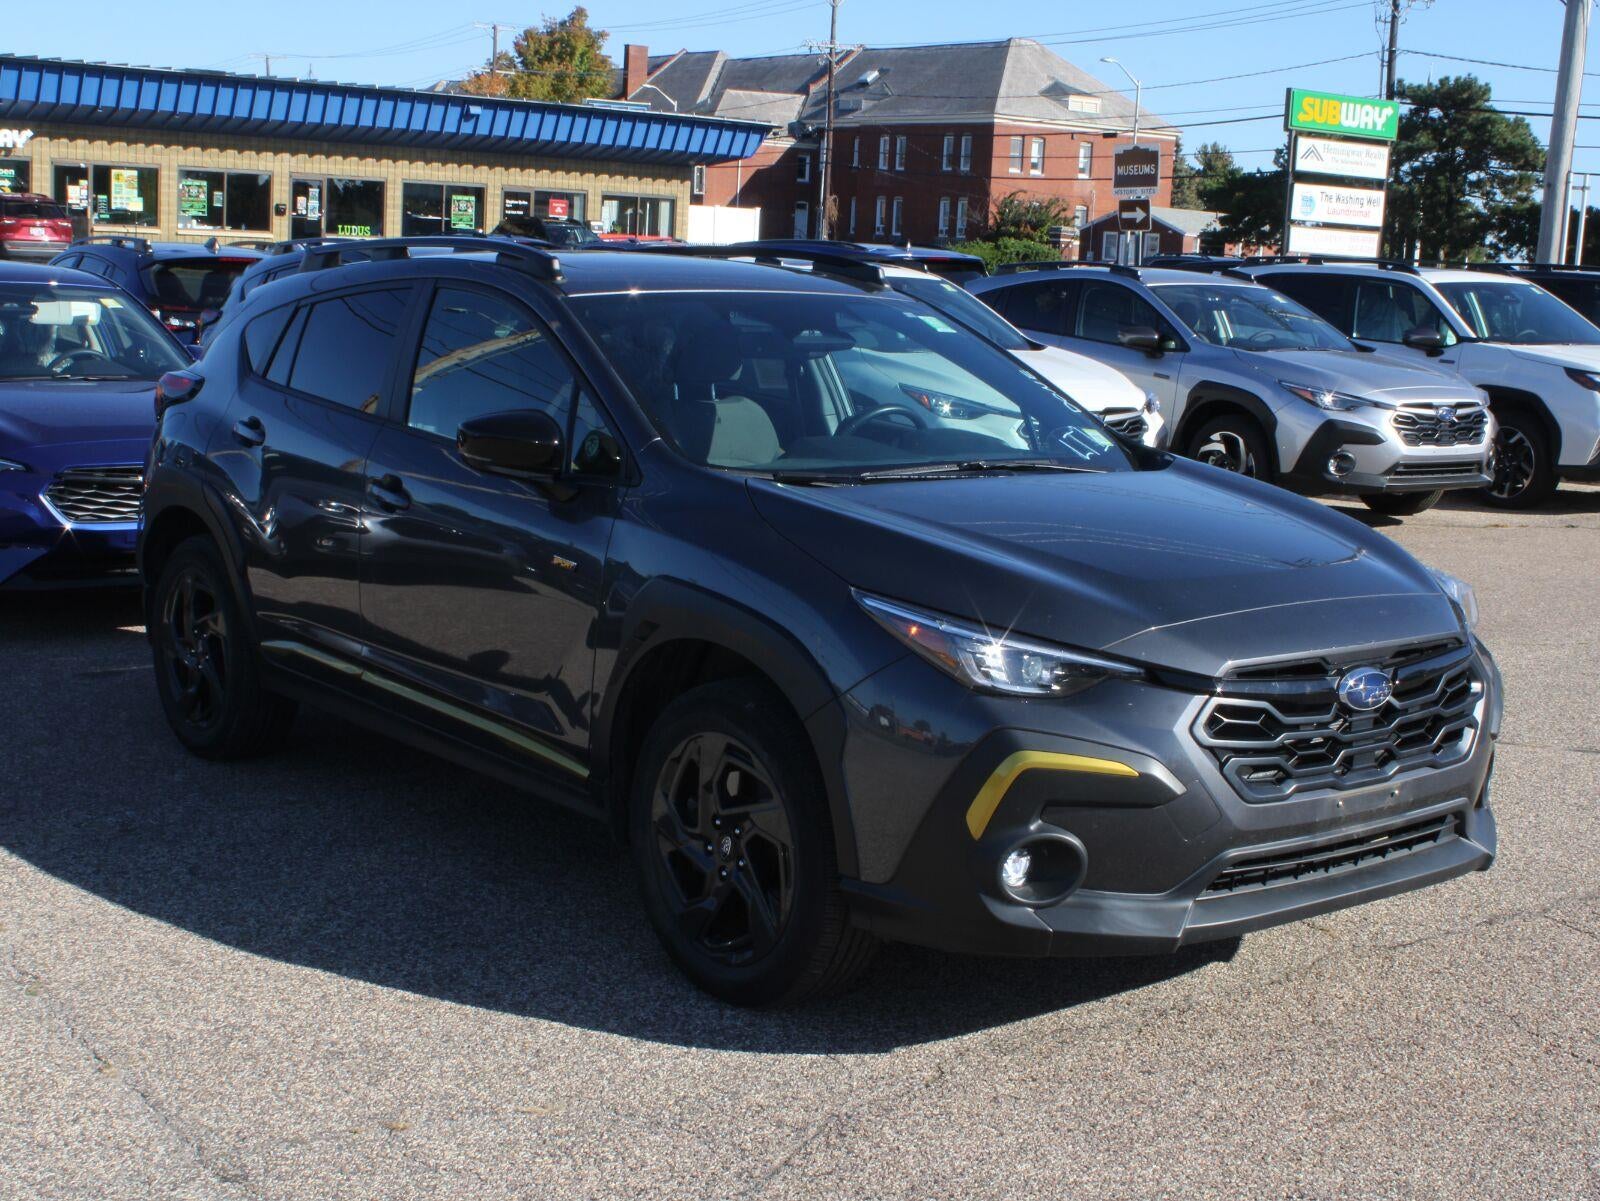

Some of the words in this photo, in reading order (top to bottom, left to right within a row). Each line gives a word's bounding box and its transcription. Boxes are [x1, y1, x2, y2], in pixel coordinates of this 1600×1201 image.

[1298, 97, 1394, 131] SUBWAY
[1117, 164, 1155, 175] MUSEUMS
[1320, 192, 1333, 203] The
[1335, 193, 1365, 209] Washing
[1366, 196, 1381, 208] Well
[1327, 206, 1371, 219] Laundromat
[337, 224, 371, 237] LUDUS
